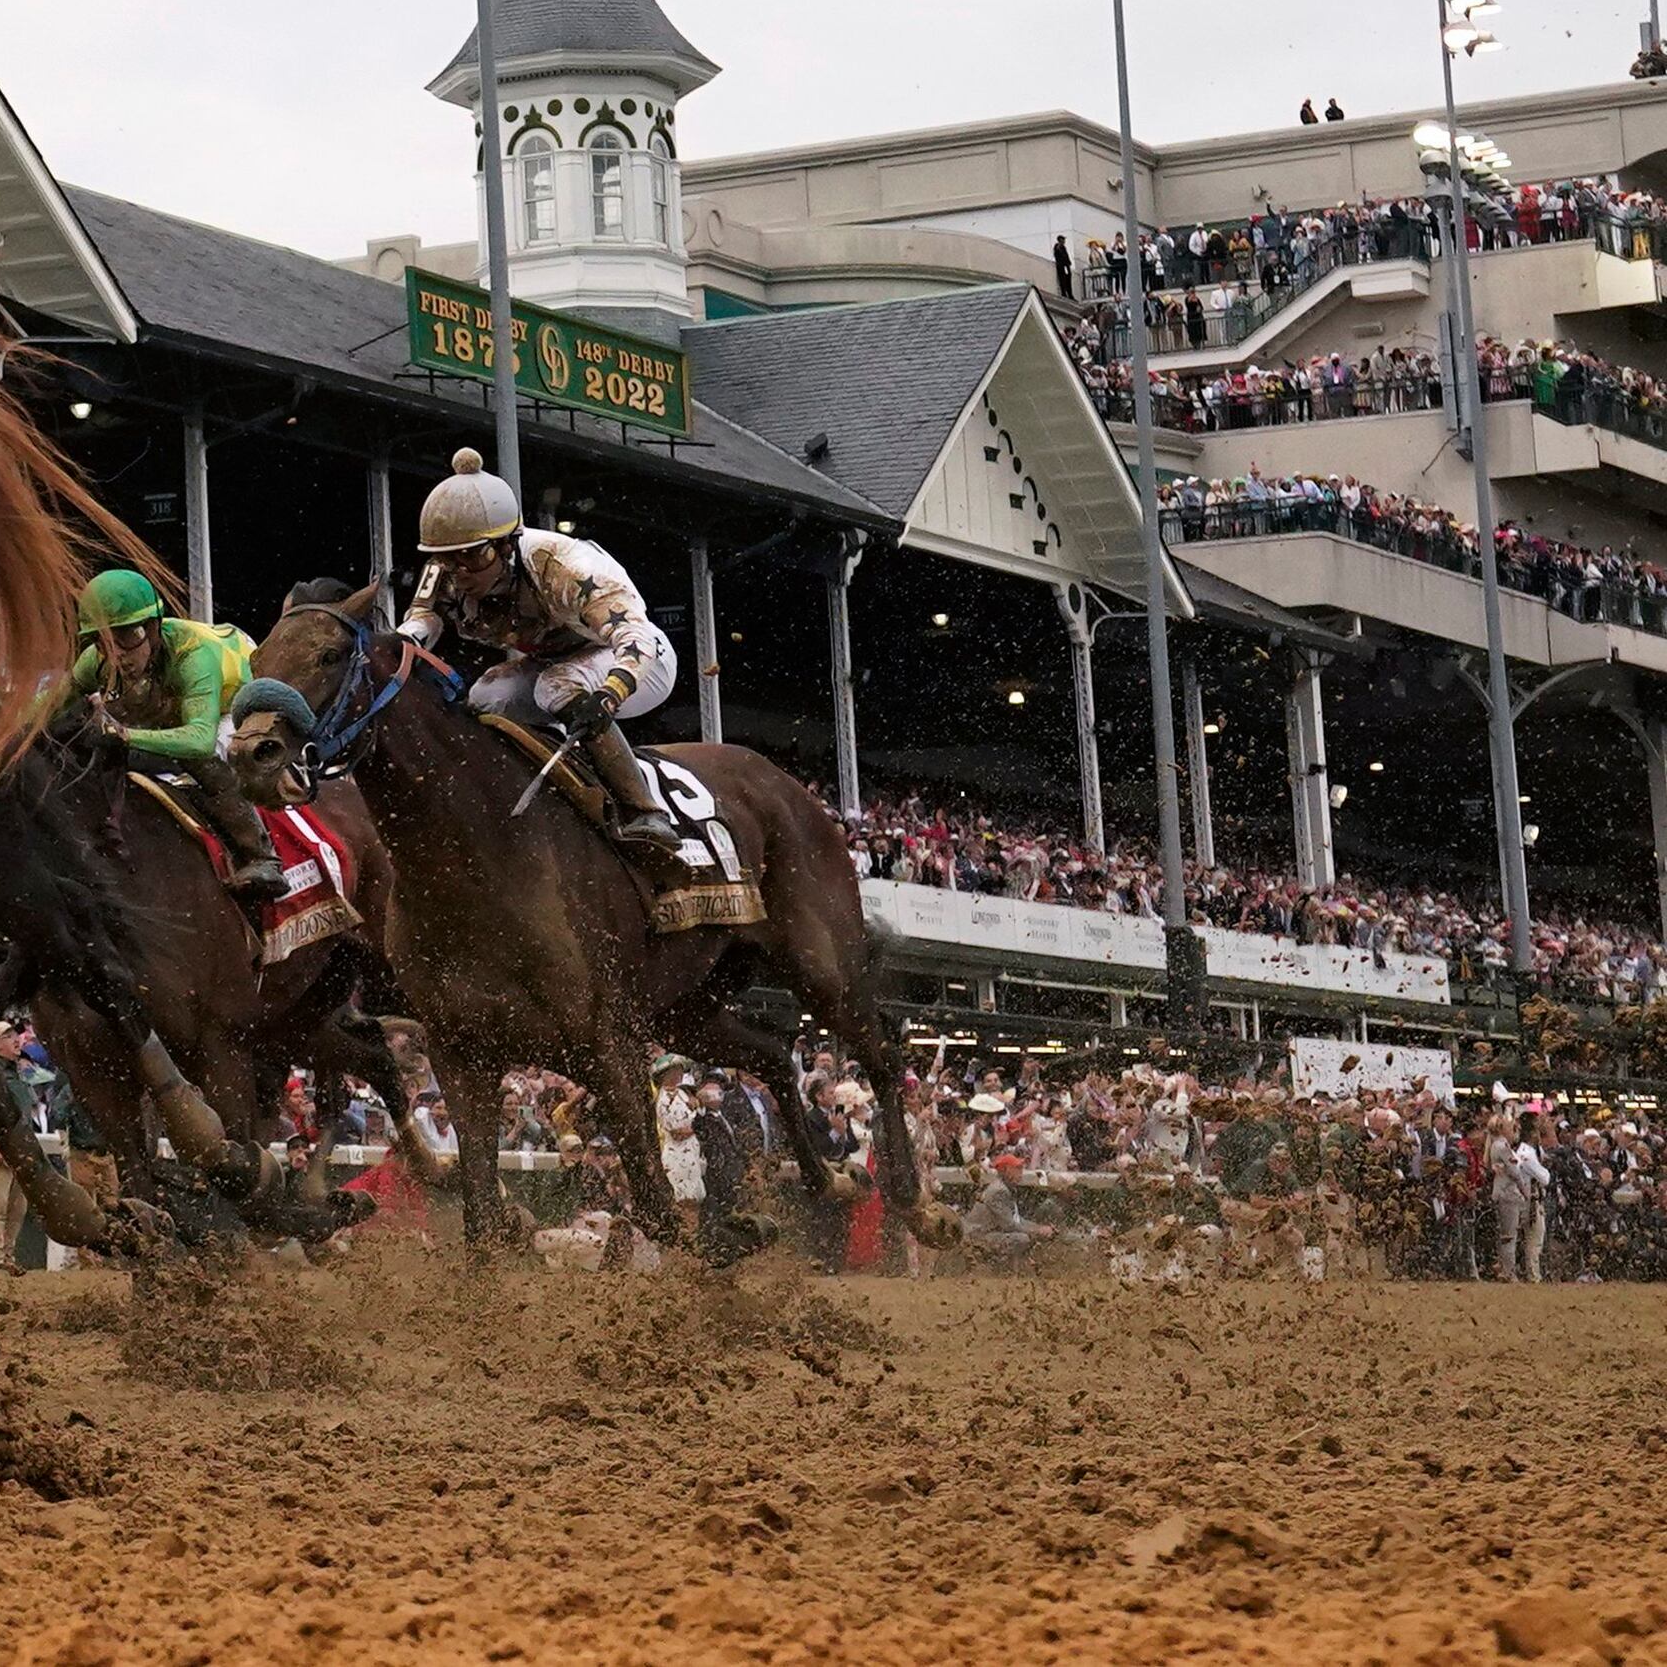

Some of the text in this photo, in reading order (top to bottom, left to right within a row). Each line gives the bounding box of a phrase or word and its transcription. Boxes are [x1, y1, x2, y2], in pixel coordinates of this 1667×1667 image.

[419, 289, 470, 324] FIRST
[618, 349, 676, 384] DERBY
[584, 366, 666, 418] 2022
[150, 501, 172, 516] 318
